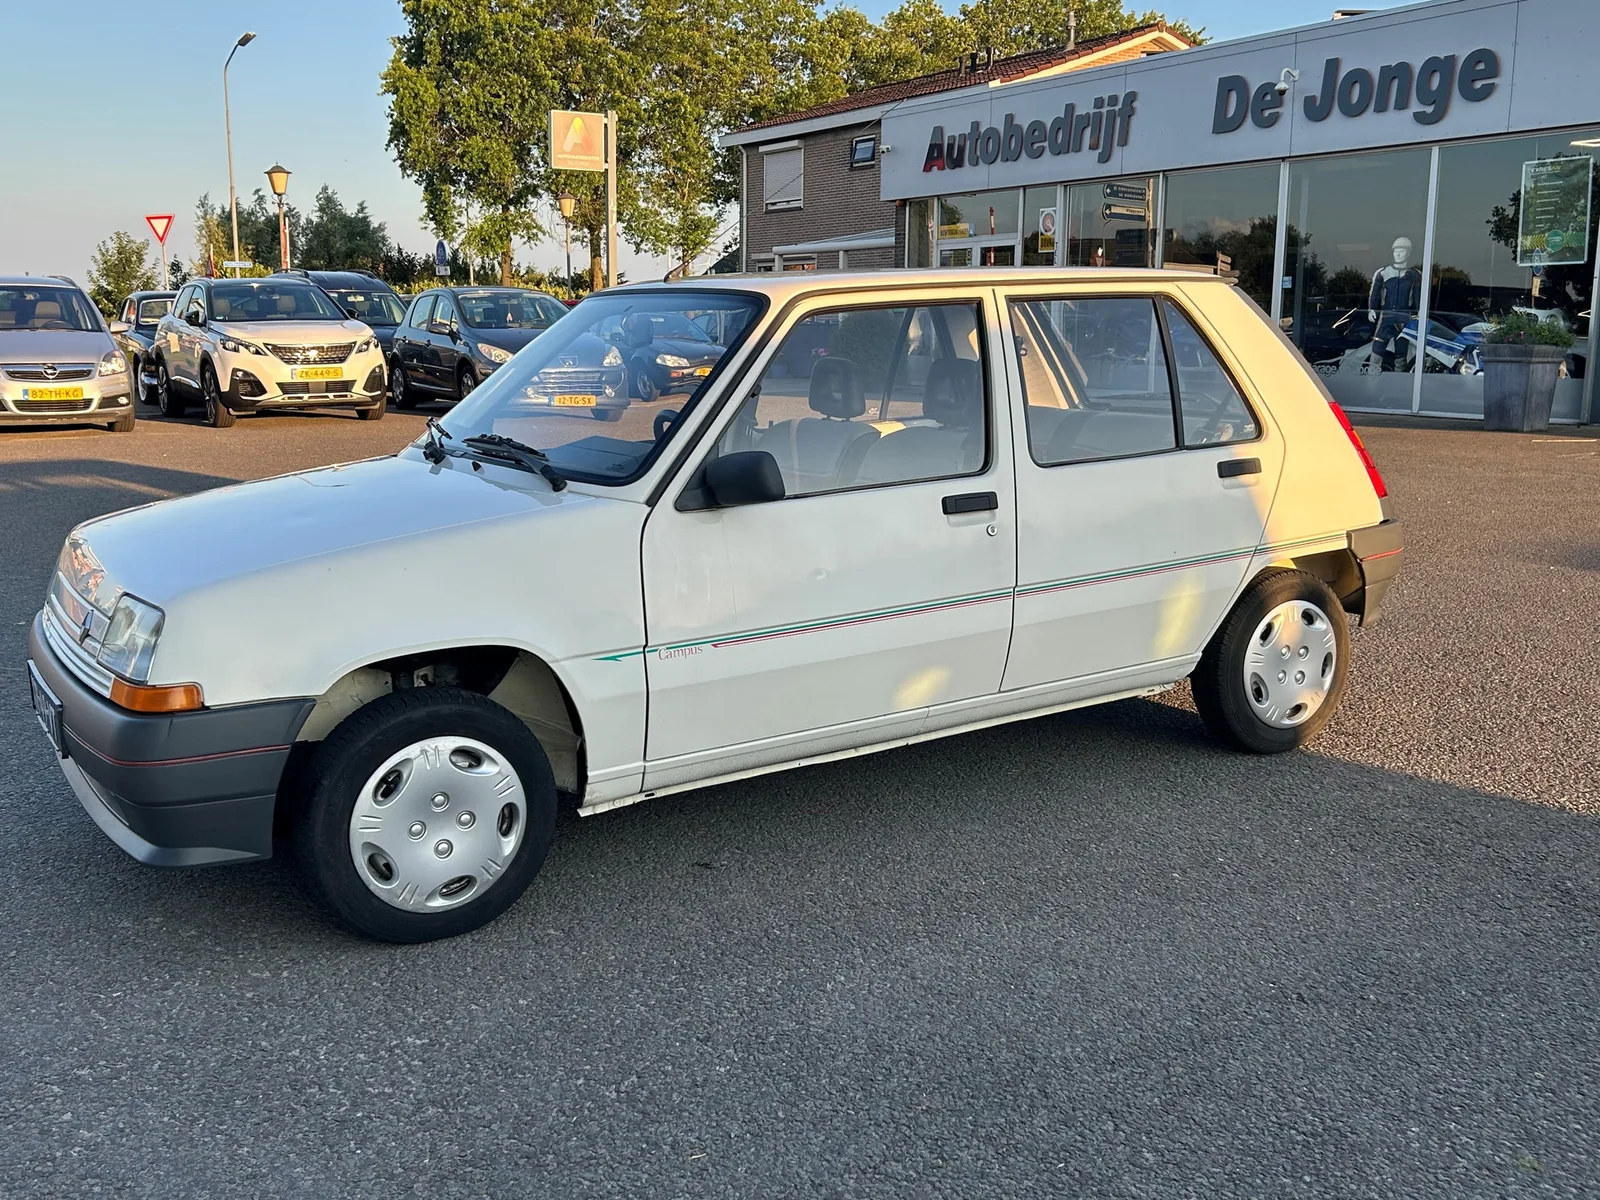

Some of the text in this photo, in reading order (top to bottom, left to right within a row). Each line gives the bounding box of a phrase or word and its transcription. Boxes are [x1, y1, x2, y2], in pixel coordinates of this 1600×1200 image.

[922, 48, 1500, 174] Autobedrijf De Jonge
[299, 369, 339, 378] ZK-449-S
[1312, 365, 1338, 377] arage
[31, 389, 79, 399] 82-TH-KG
[558, 396, 592, 405] 12-TG-SX
[658, 646, 703, 660] Campus
